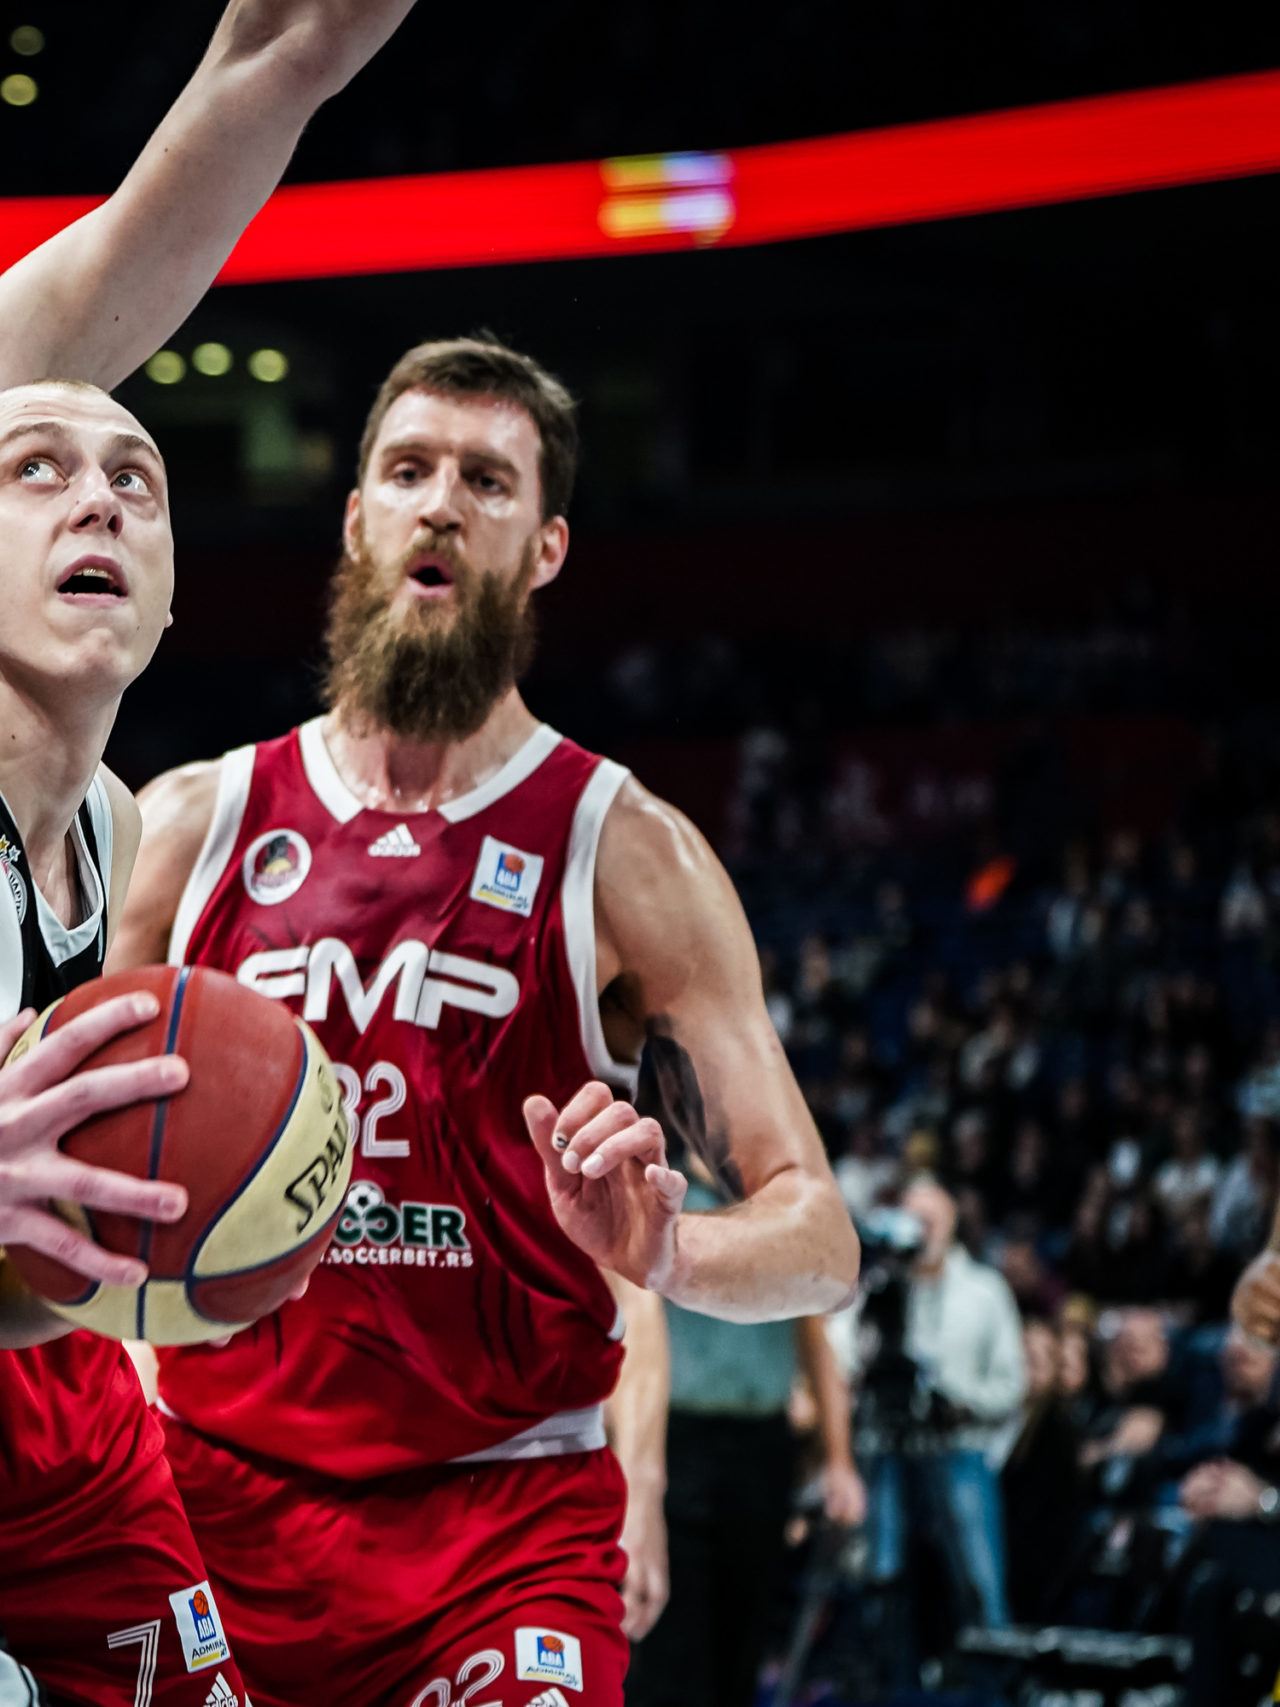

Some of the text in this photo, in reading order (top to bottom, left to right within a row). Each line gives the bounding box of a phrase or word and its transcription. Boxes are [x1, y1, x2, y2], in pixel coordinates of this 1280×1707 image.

[237, 937, 520, 1035] FMP
[284, 1096, 349, 1235] SPAL
[320, 1247, 474, 1268] .SOCCERBET.RS
[333, 1201, 471, 1250] CCER
[107, 1619, 161, 1707] 7
